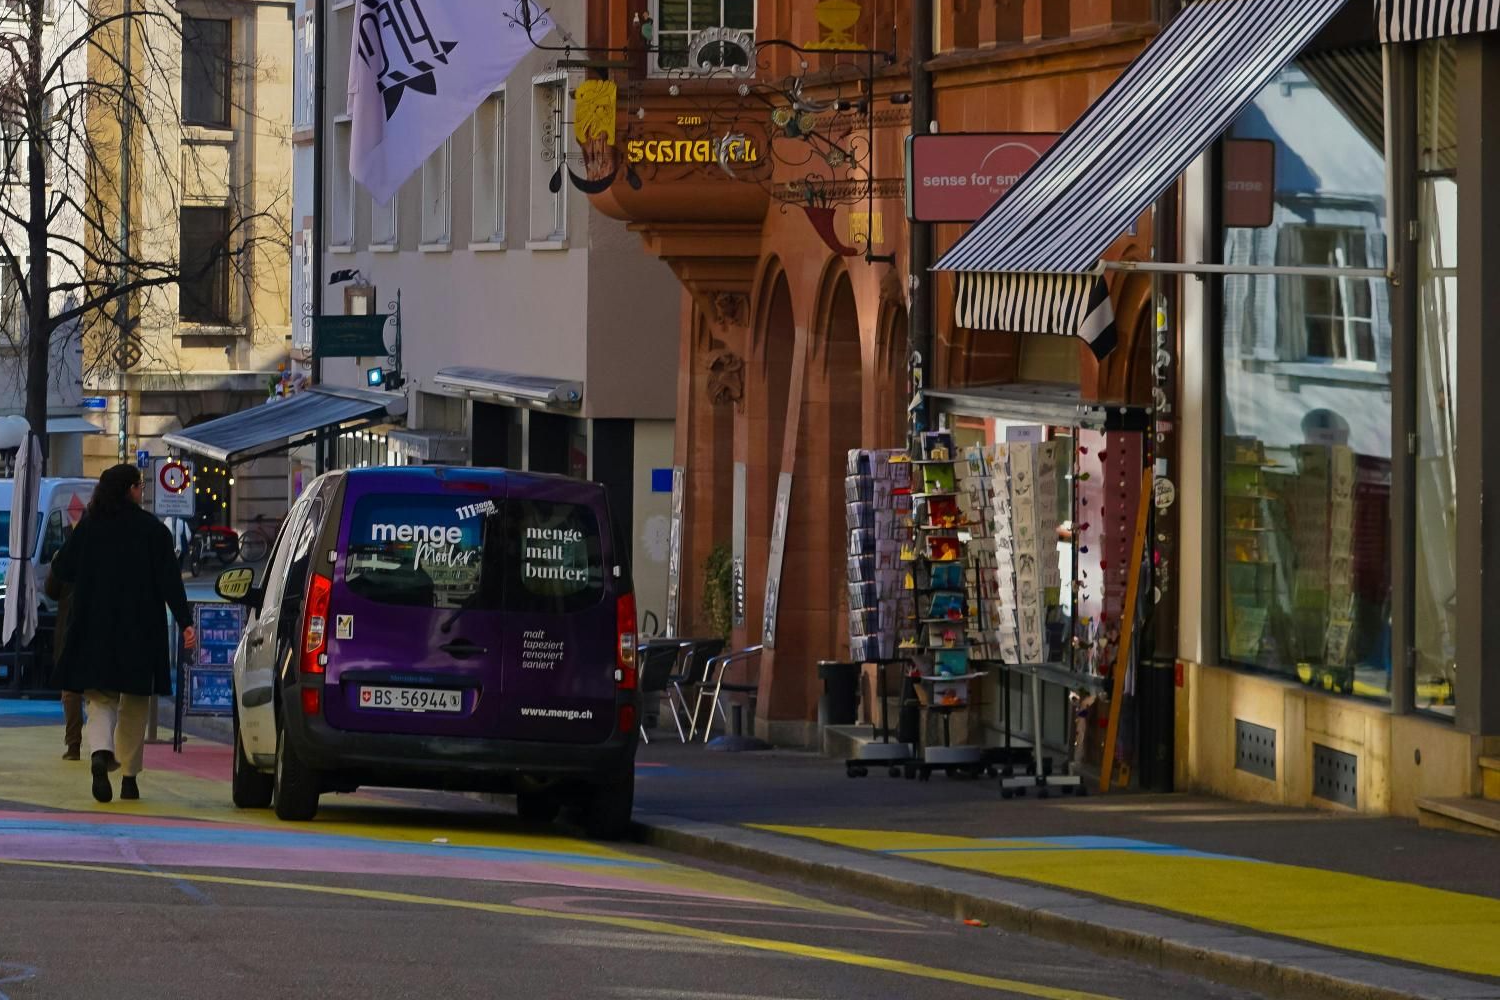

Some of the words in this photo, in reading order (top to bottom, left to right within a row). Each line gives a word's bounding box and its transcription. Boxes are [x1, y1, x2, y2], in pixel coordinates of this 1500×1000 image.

[676, 115, 702, 125] zum
[923, 175, 967, 187] sense
[970, 172, 993, 186] for
[455, 503, 477, 521] 111
[371, 523, 463, 548] menge
[526, 527, 583, 544] menge
[526, 544, 564, 561] malt
[525, 562, 587, 582] bunter.
[523, 629, 546, 639] malt
[522, 639, 565, 651] tapeziert
[522, 650, 565, 661] renoviert
[522, 660, 555, 670] saniert
[374, 689, 392, 705] BS
[520, 707, 593, 721] www.menge.ch
